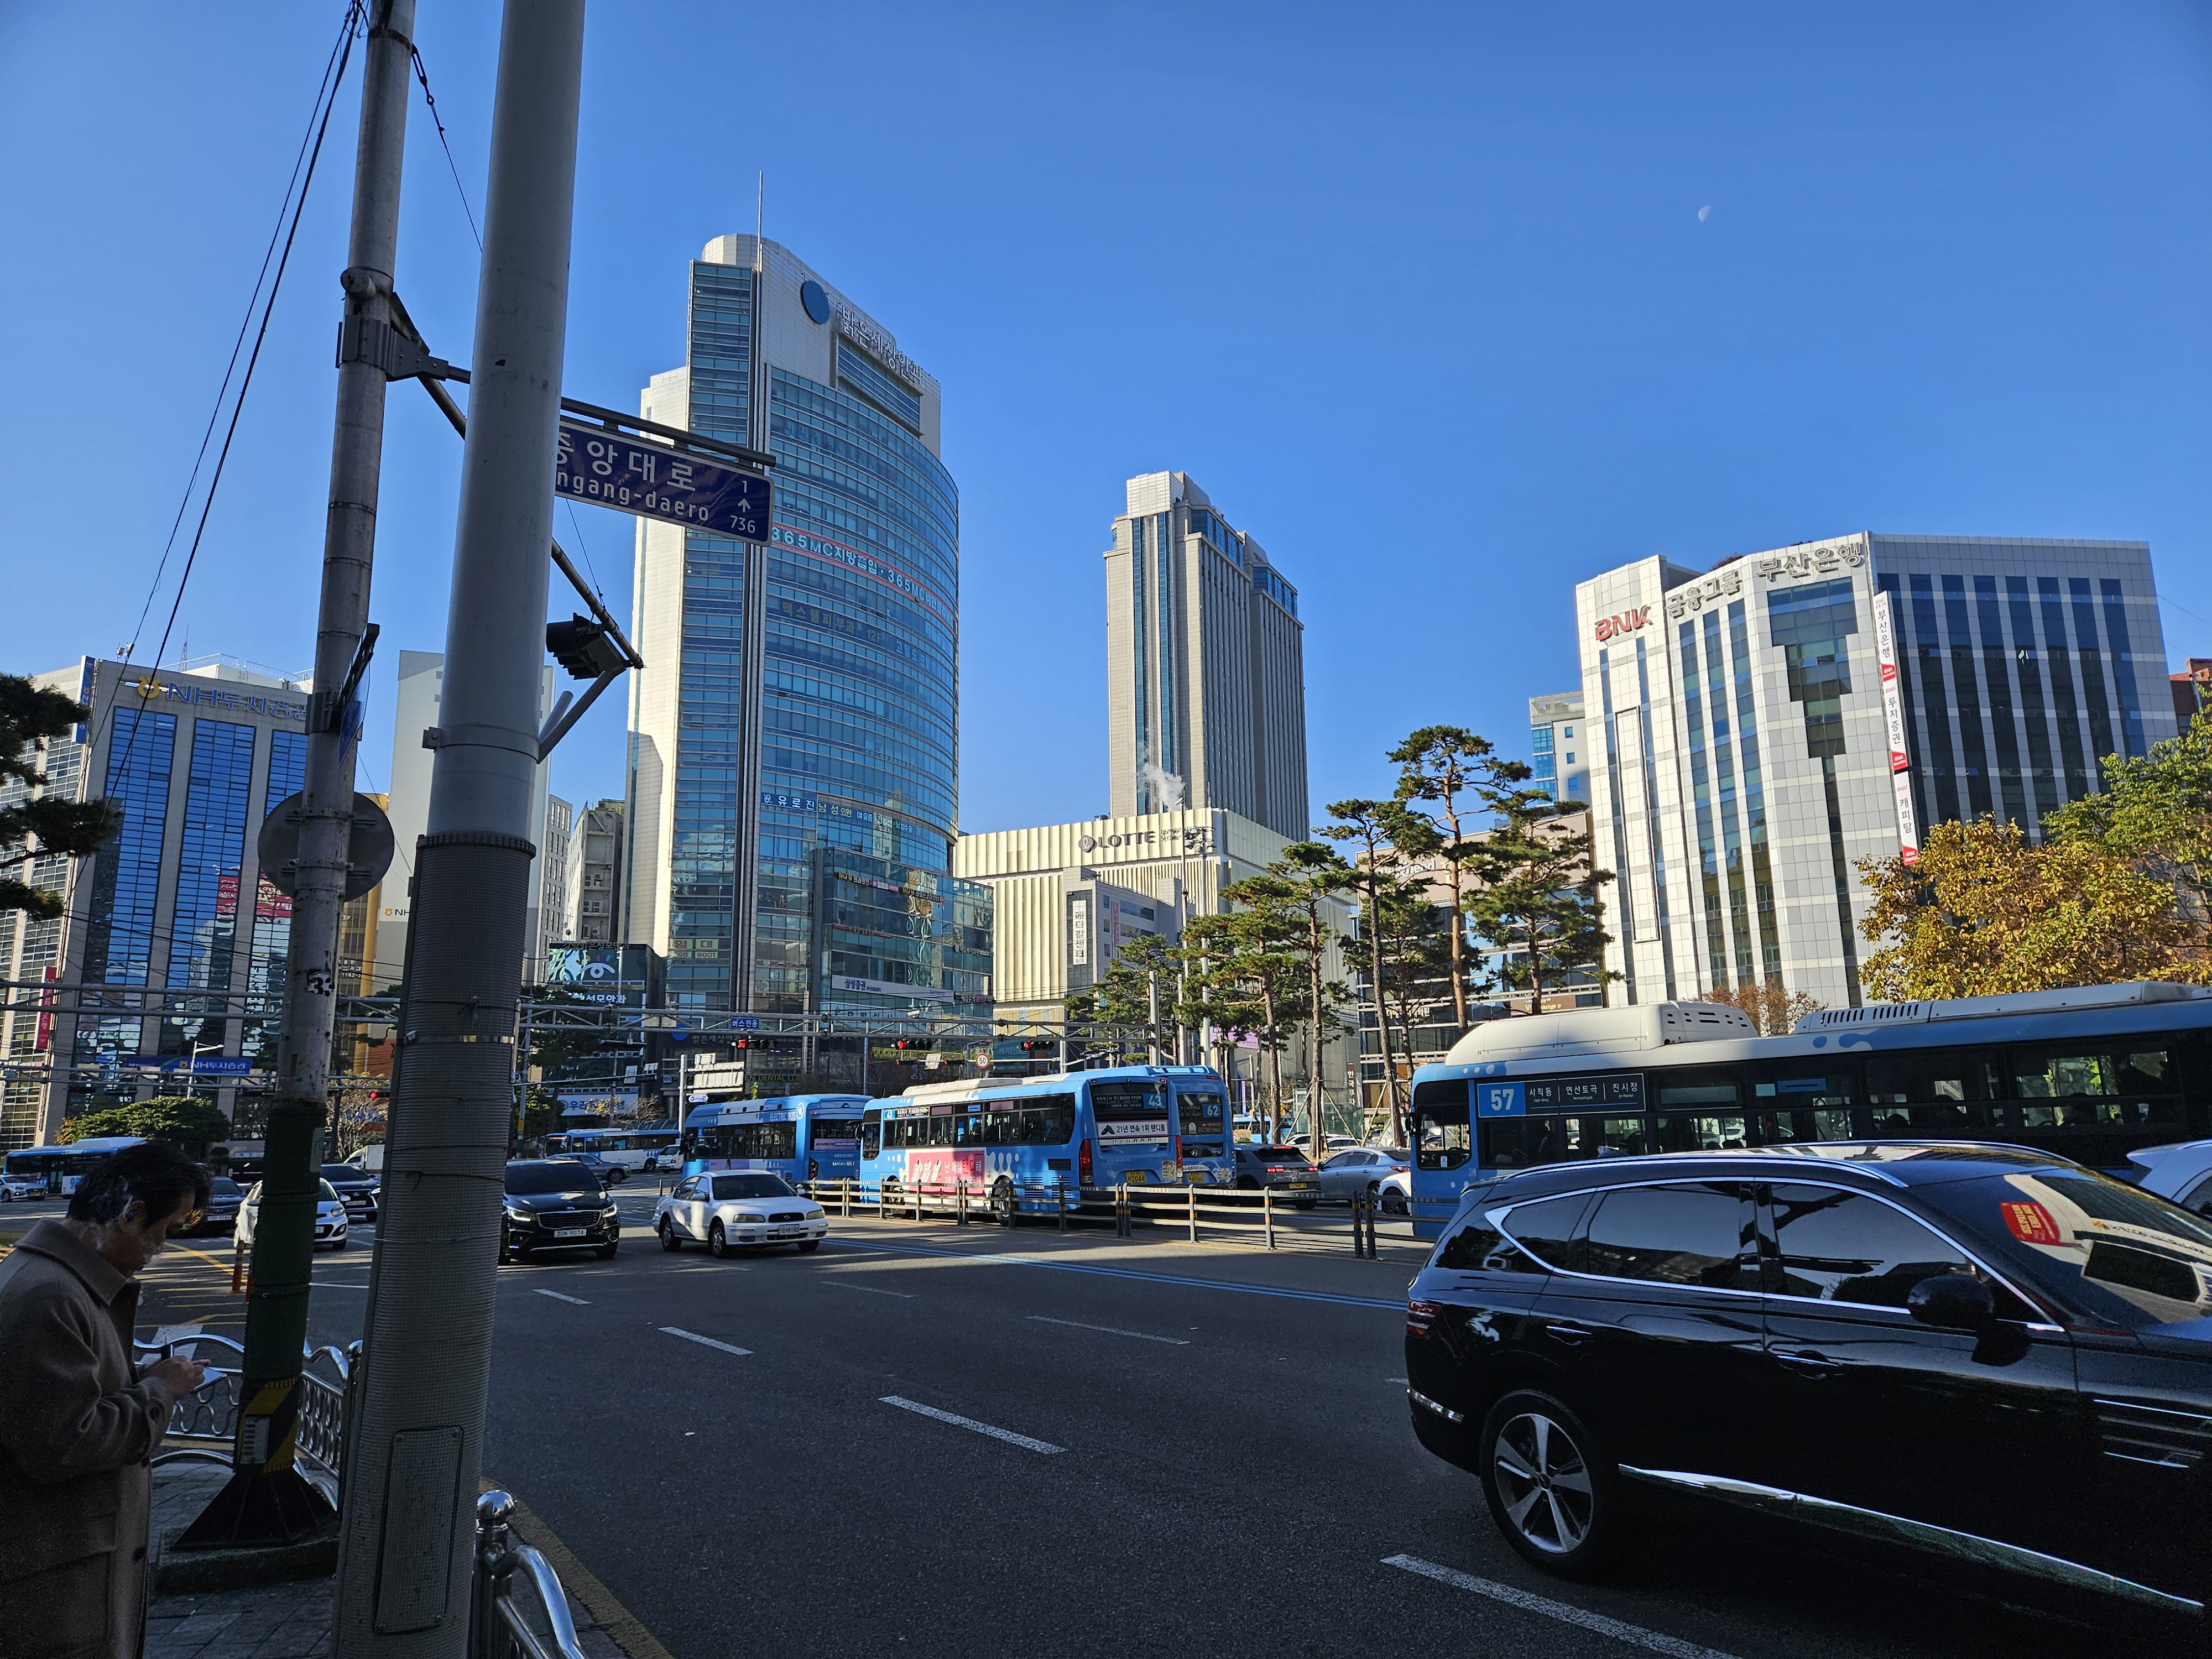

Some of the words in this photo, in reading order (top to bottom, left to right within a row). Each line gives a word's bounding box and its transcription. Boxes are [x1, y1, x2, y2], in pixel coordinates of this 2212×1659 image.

[842, 306, 922, 384] 밝은세상안과
[743, 480, 747, 493] 1
[730, 515, 756, 534] 736
[1595, 605, 1653, 641] BNK
[1666, 569, 1743, 619] 금융그룹
[1756, 542, 1864, 581] 부산은행
[867, 629, 882, 643] 12F
[1878, 609, 1891, 659] 부산은행
[1886, 685, 1897, 693] BNK
[1888, 697, 1901, 744] 투자증권
[1899, 797, 1912, 834] 캐피탈
[1098, 830, 1157, 848] LOTTE
[844, 978, 867, 990] 삼성증권
[732, 1018, 758, 1028] 버스전용
[1148, 1094, 1162, 1107] 43
[1491, 1089, 1514, 1111] 57
[1529, 1087, 1552, 1097] 사직동
[1566, 1084, 1598, 1096] 연산토곡
[1612, 1082, 1639, 1093] 진시장
[770, 1113, 787, 1121] ELECTRIC
[787, 1112, 796, 1120] BUS
[1207, 1105, 1219, 1116] 62
[1117, 1125, 1128, 1133] 21년
[1130, 1124, 1140, 1133] 연속
[945, 1161, 950, 1174] 난
